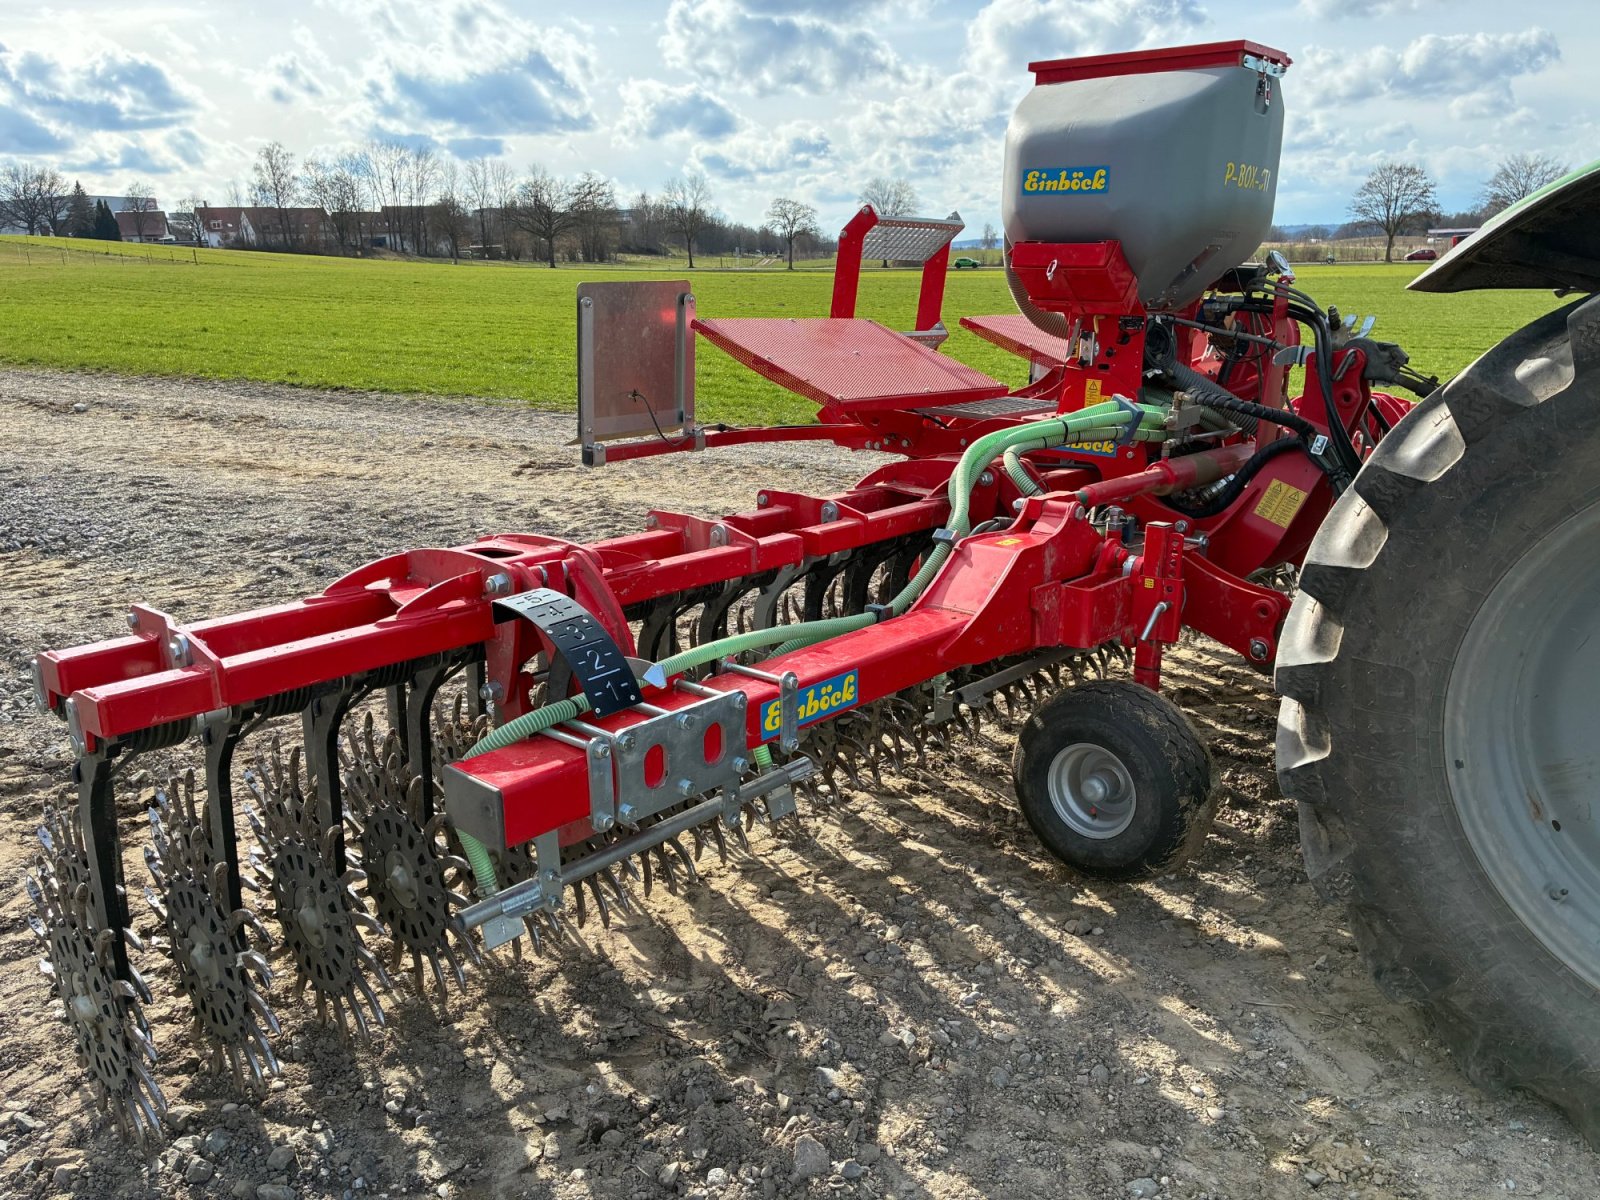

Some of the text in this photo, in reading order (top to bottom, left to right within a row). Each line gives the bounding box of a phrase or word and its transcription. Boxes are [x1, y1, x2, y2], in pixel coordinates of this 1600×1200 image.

[1023, 168, 1106, 191] Einböck
[524, 595, 542, 604] 5
[549, 605, 565, 617] 4
[566, 623, 585, 641] 3
[586, 649, 606, 671] 2
[605, 680, 619, 701] 1
